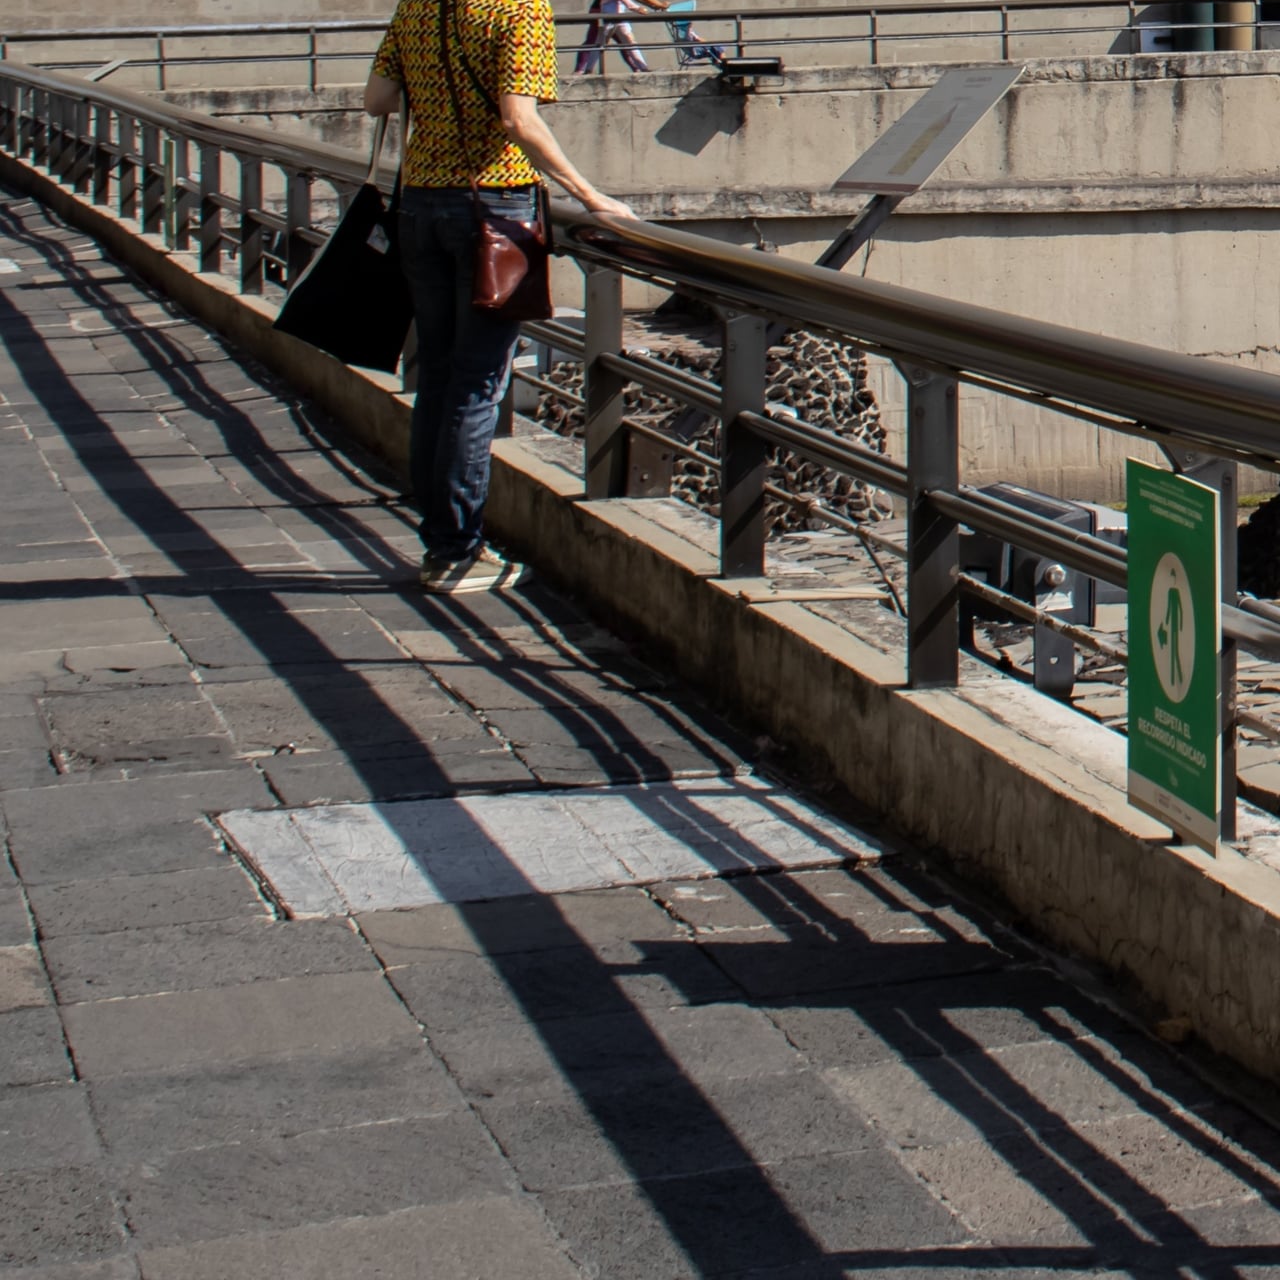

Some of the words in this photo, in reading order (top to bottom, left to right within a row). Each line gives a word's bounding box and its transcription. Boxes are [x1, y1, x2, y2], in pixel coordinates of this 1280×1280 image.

[1138, 717, 1175, 749] RECORRIDO
[1175, 738, 1206, 768] INDICADO
[1154, 706, 1183, 735] RESPETA
[1183, 722, 1191, 740] EL
